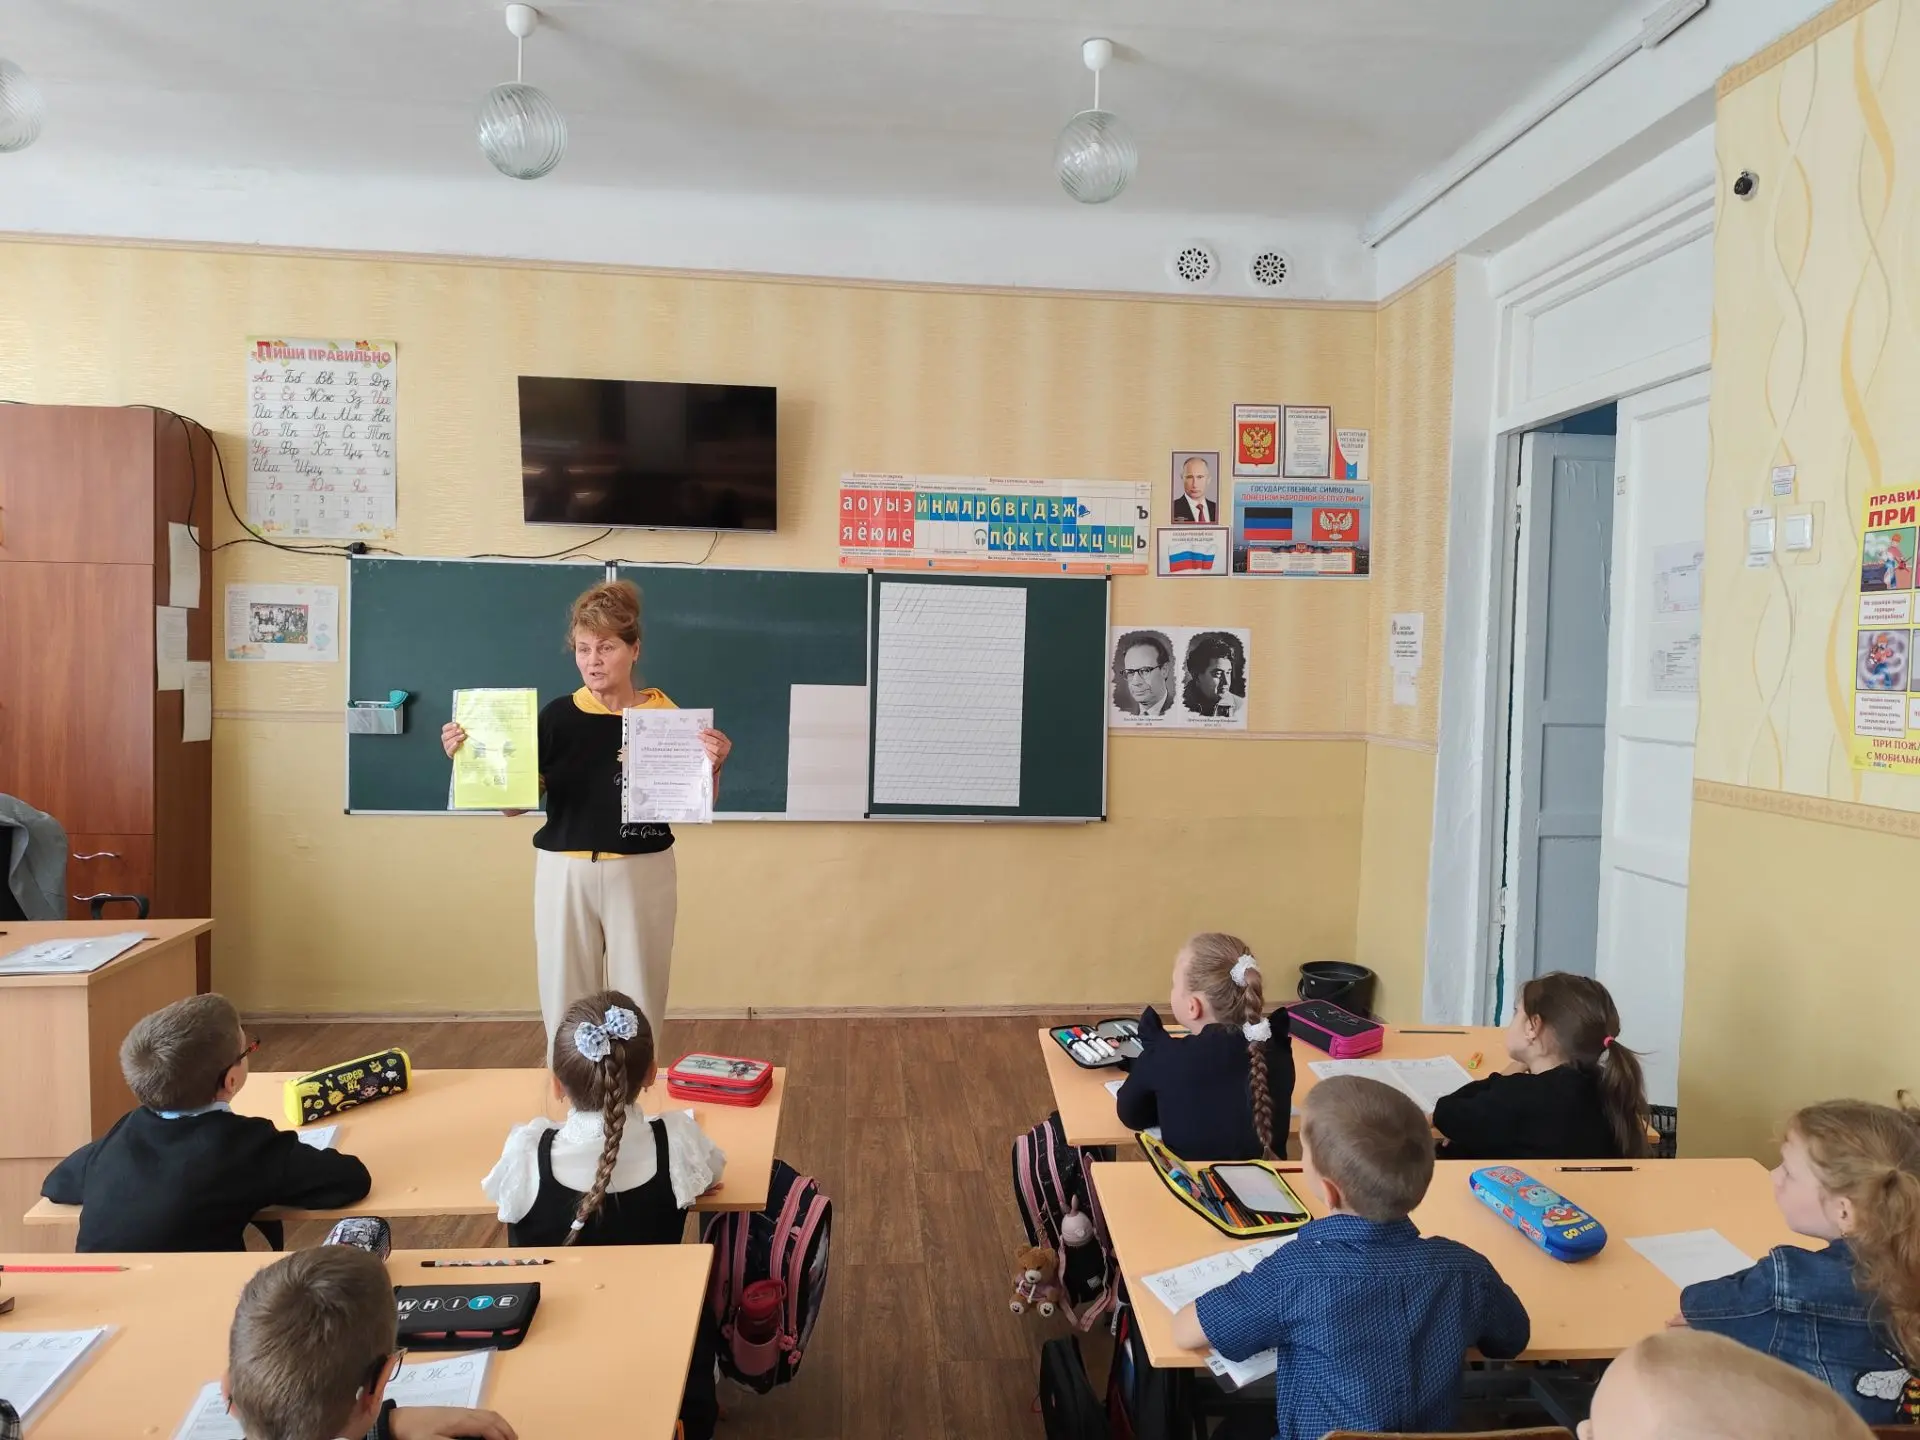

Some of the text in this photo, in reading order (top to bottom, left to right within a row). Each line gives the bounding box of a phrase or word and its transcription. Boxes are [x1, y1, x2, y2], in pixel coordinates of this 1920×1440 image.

[257, 341, 391, 361] ПИШИ ПРАВИЛЬНО
[1868, 506, 1915, 527] ПРИ
[1873, 739, 1892, 748] ПРИ
[337, 1069, 364, 1085] SUPER
[398, 1297, 513, 1311] WHITE
